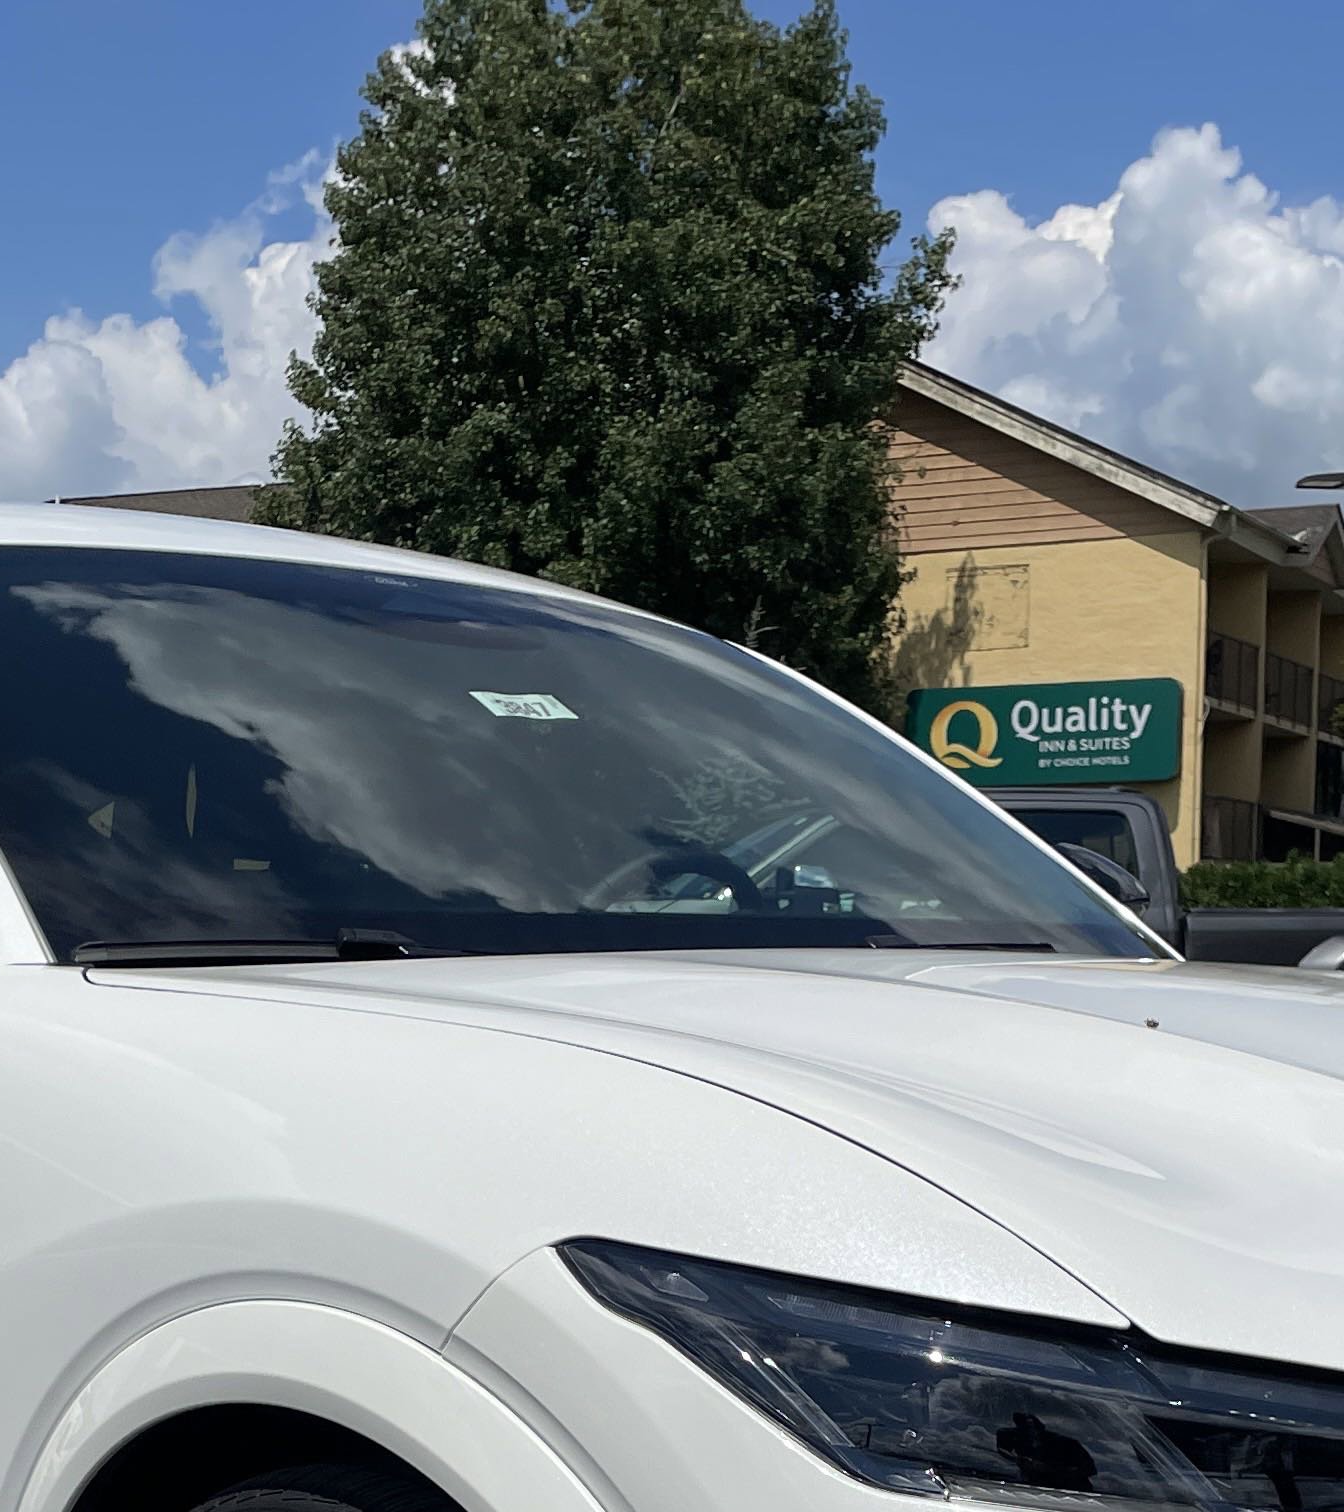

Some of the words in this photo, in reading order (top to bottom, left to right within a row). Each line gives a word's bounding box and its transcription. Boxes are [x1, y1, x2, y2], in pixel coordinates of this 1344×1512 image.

[1011, 697, 1152, 742] Quality
[1038, 740, 1066, 753] INN
[1066, 739, 1077, 752] &
[1079, 737, 1131, 751] SUITES
[1038, 758, 1052, 768] BY
[1053, 757, 1090, 767] CHOICE
[1091, 755, 1130, 766] HOTELS
